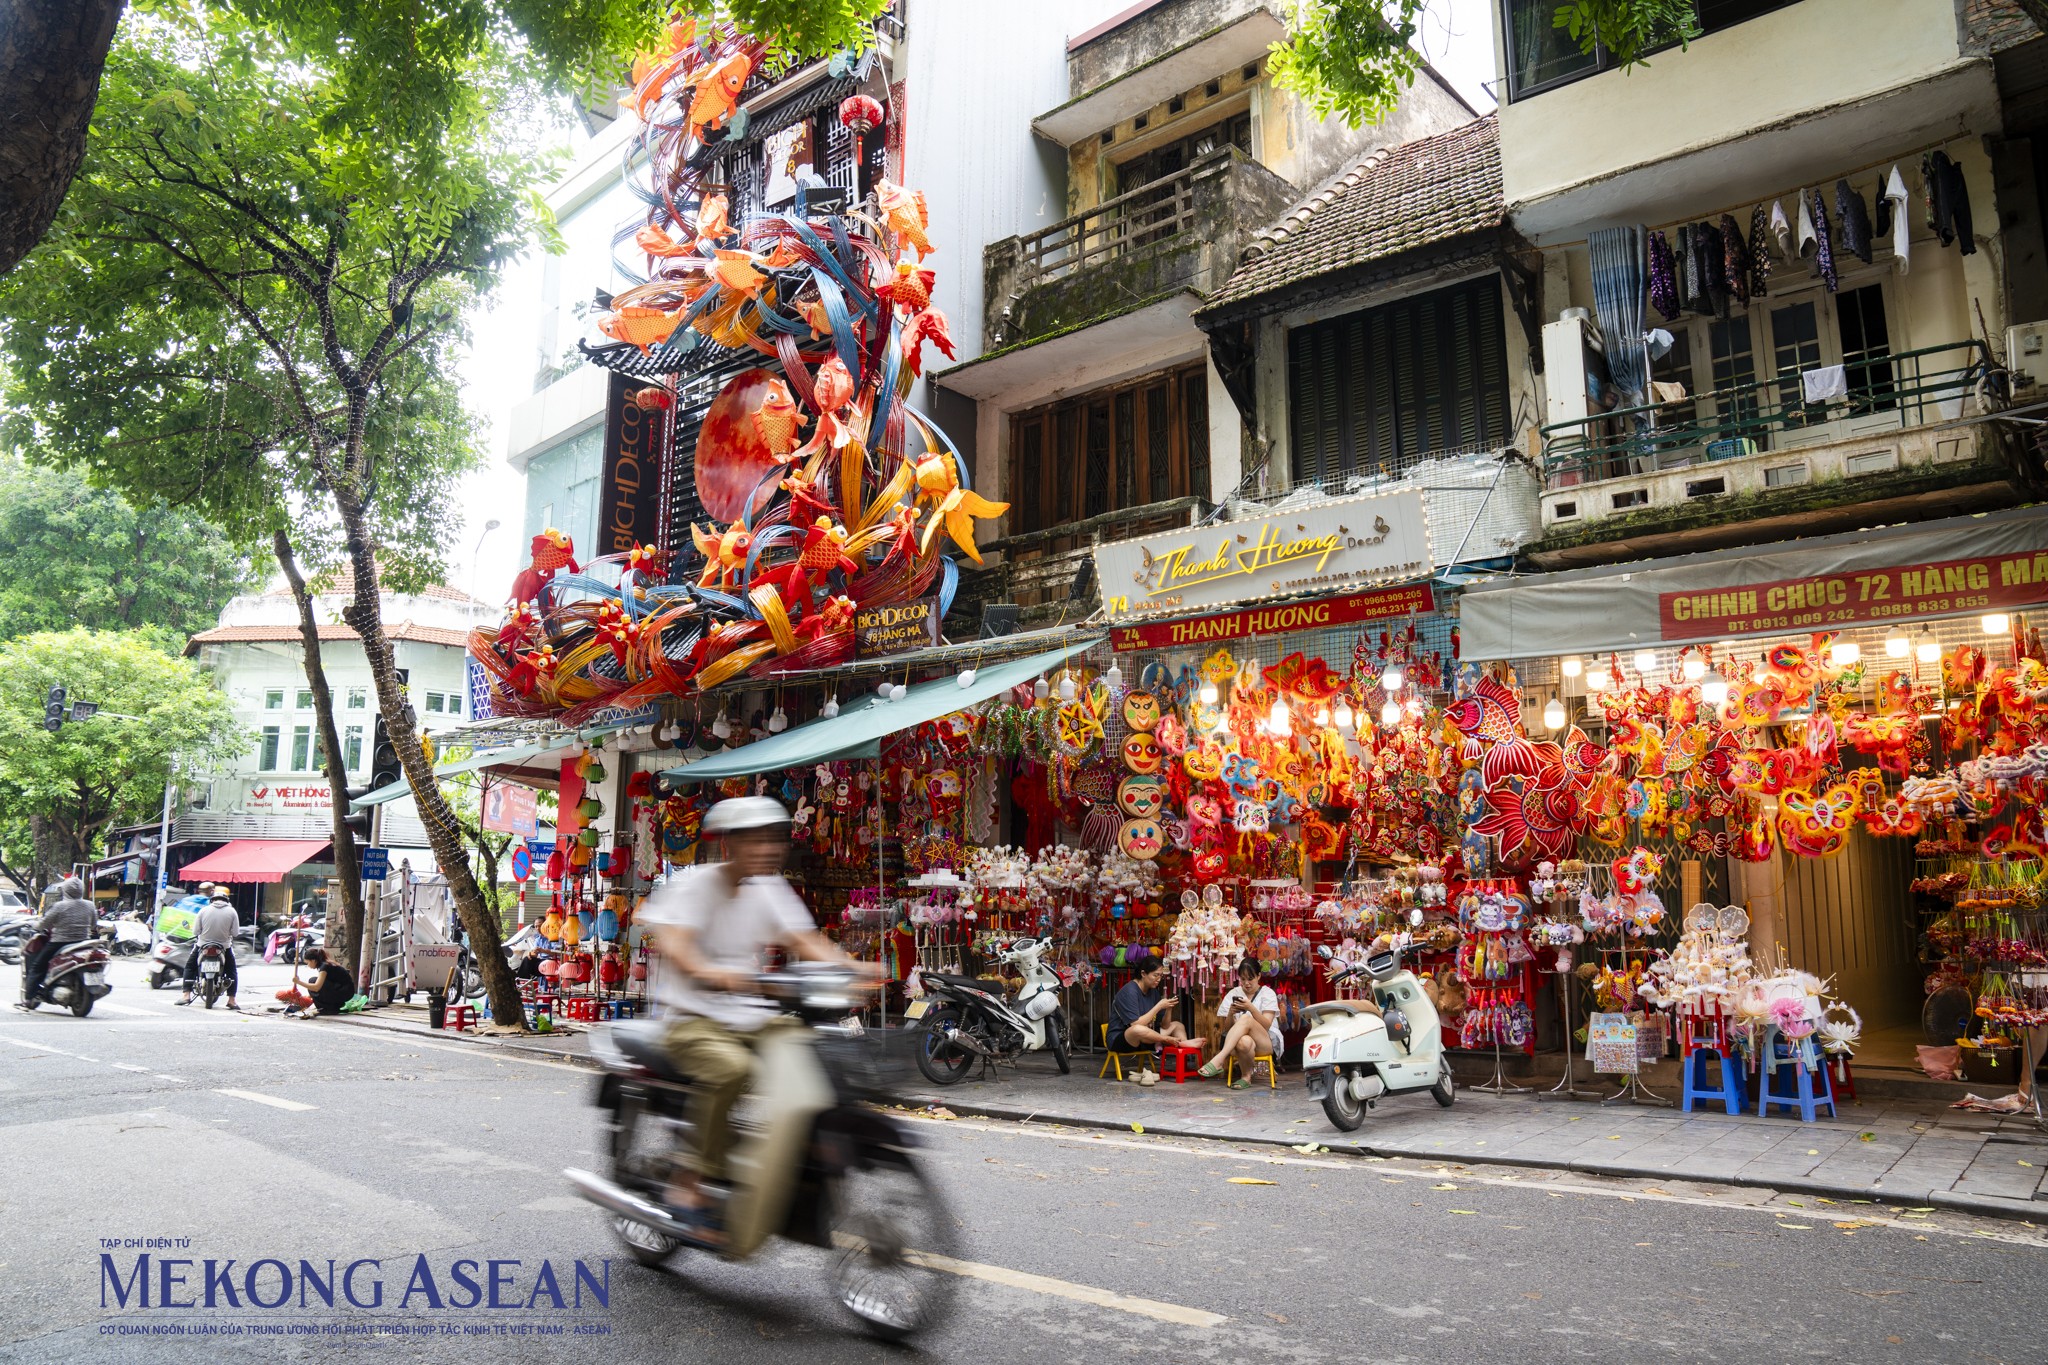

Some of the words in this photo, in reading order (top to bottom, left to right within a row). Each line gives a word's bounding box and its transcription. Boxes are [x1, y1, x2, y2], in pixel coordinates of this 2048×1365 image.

[1154, 539, 1231, 587] Thanh
[1673, 591, 1758, 621] CHINH
[1767, 578, 1847, 612] CHÚC
[1855, 574, 1891, 602] 72
[1901, 565, 1990, 597] HÀNG
[2000, 552, 2048, 587] MÃ
[1109, 595, 1129, 615] 74
[1349, 599, 1363, 608] ĐT:
[1364, 589, 1422, 606] 0966.909.205
[1170, 614, 1241, 642] THANH
[1248, 603, 1330, 633] HƯƠNG
[1728, 621, 1749, 632] ĐT:
[1753, 616, 1788, 630] 0913
[1793, 612, 1822, 625] 009
[1827, 608, 1855, 622] 242
[1870, 603, 1912, 617] 0988
[1917, 599, 1950, 613] 833
[1955, 595, 1989, 609] 855
[1122, 628, 1140, 641] 74
[275, 786, 298, 799] VIỆT
[419, 948, 456, 958] mobifone
